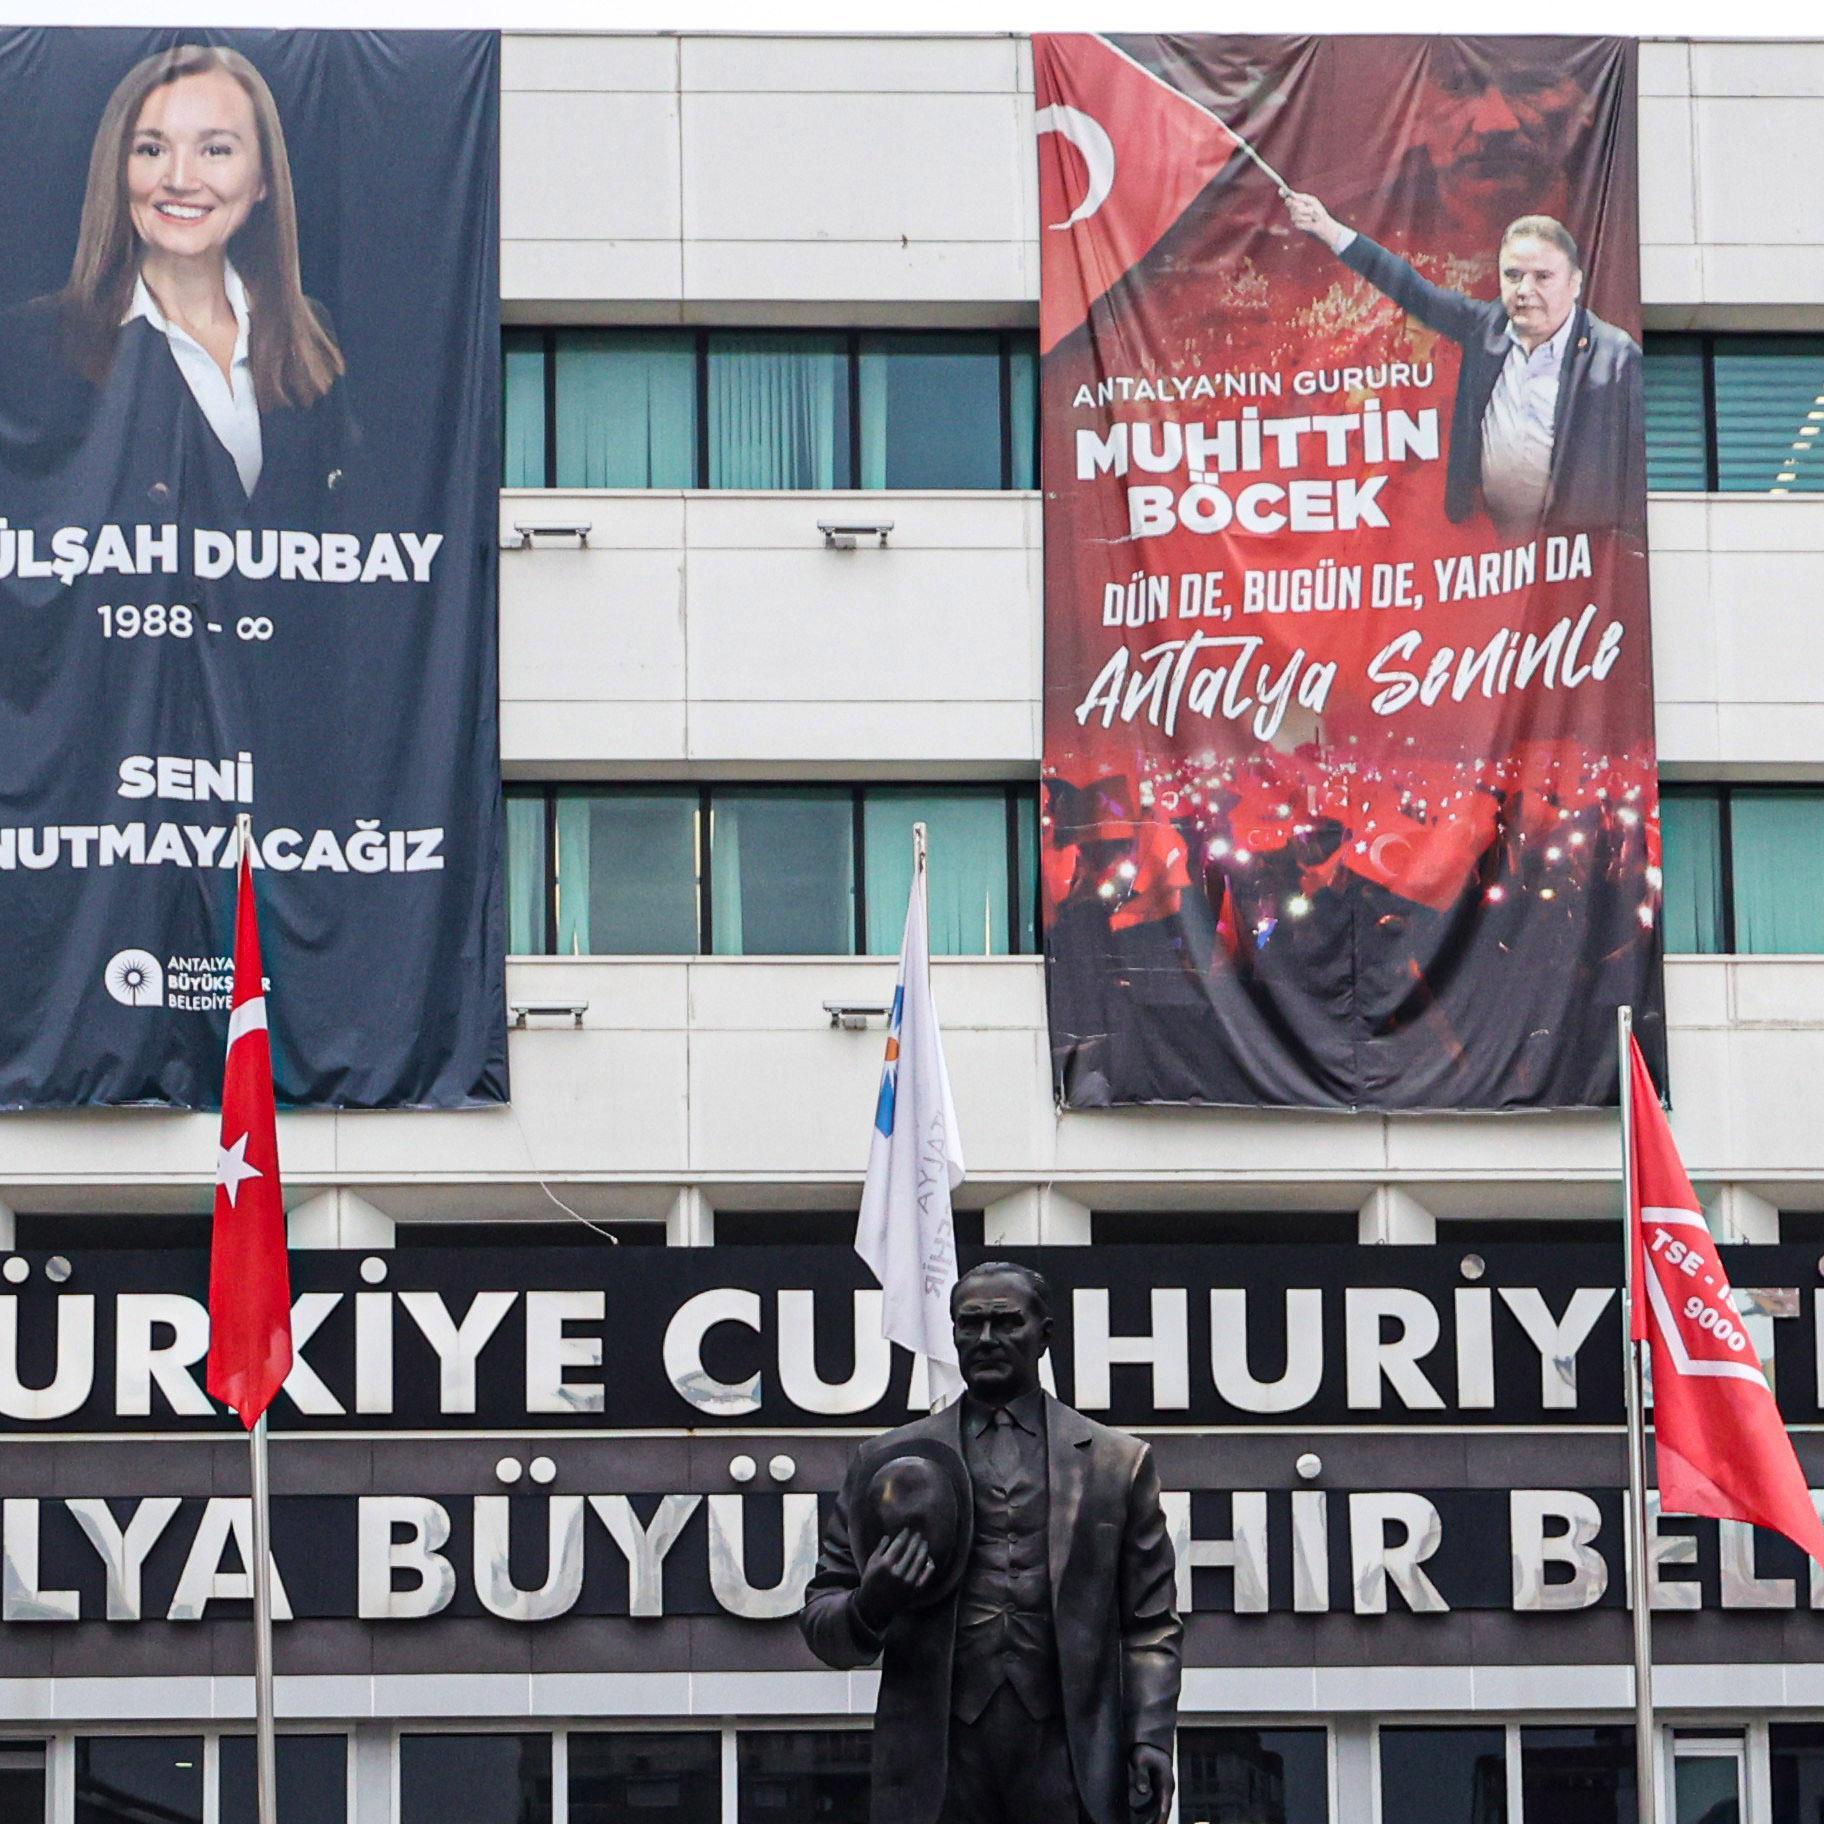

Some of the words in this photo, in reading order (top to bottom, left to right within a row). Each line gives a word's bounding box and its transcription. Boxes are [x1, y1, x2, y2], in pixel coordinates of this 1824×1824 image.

[1073, 368, 1282, 409] ANTALYA'NIN
[1293, 362, 1434, 396] GURURU
[1077, 399, 1439, 482] MUHİTTİN
[1127, 471, 1390, 538] BÖCEK
[194, 529, 444, 583] DURBAY
[1103, 571, 1171, 629] DÜN
[1179, 571, 1232, 621] DE,
[1243, 558, 1362, 615] BUGÜN
[1372, 562, 1424, 611] DE,
[1433, 541, 1538, 603] YARIN
[1544, 533, 1592, 584] DA
[98, 604, 195, 639] 1988
[1075, 630, 1338, 743] Antalya
[1367, 603, 1626, 717] Seninle
[117, 752, 254, 804] SENİ
[167, 956, 235, 972] ANTALYA
[168, 972, 272, 993] BÜYÜKŞR
[1651, 1227, 1705, 1278] TSE
[1683, 1296, 1746, 1352] 9000
[358, 1453, 1451, 1622] BÜYÜHİR
